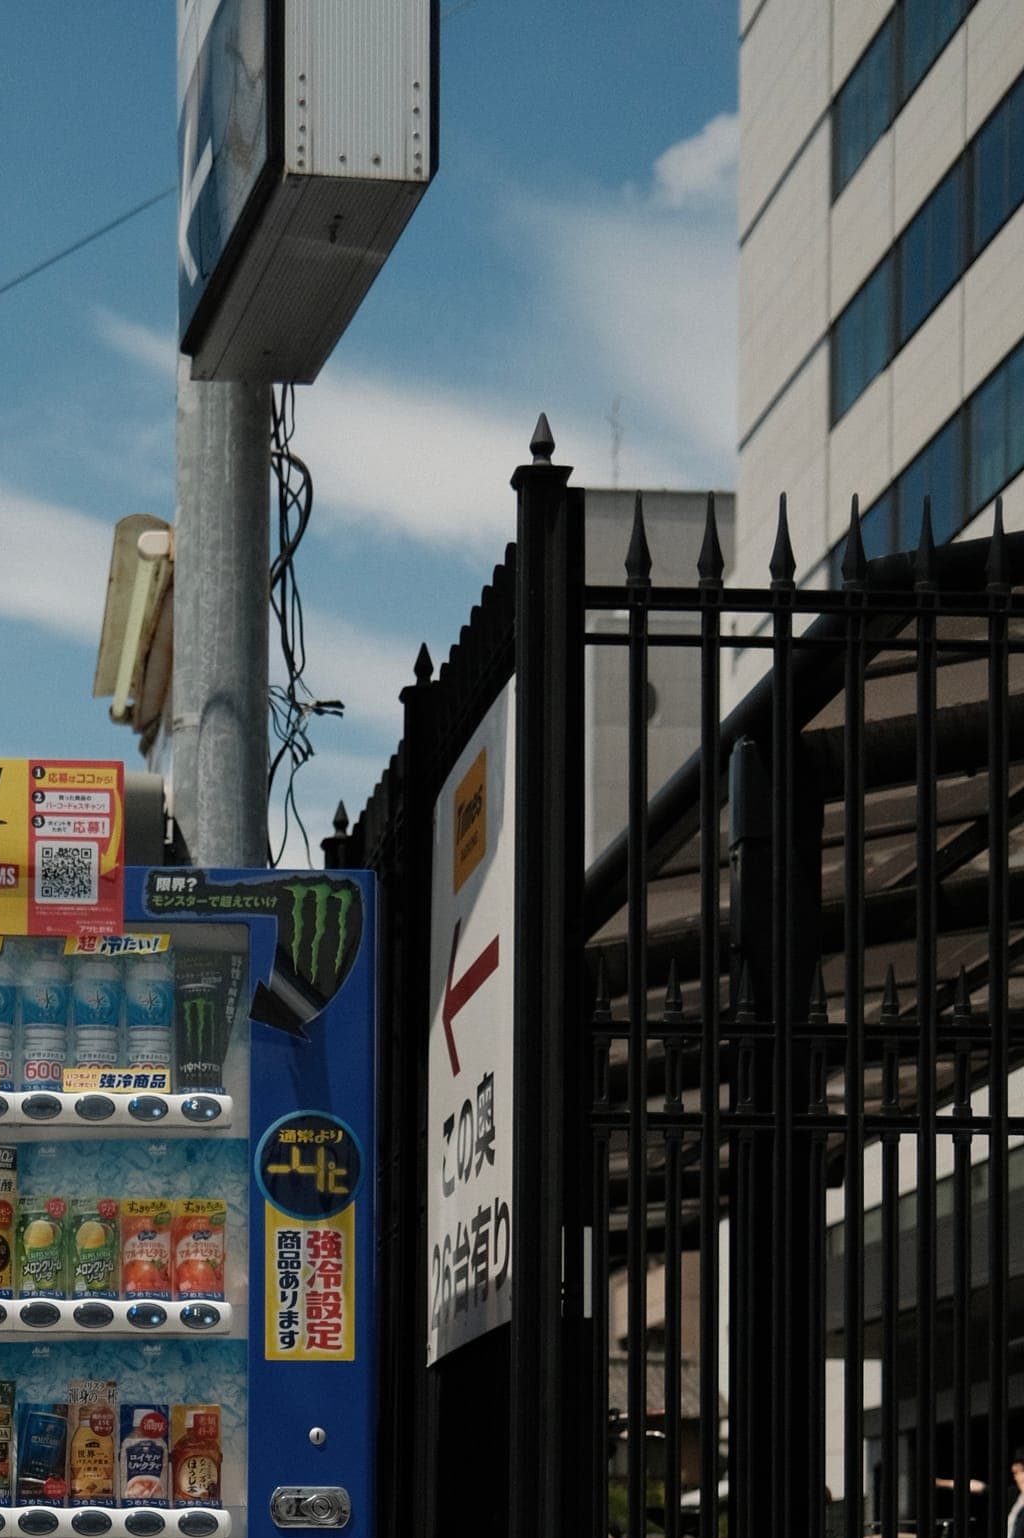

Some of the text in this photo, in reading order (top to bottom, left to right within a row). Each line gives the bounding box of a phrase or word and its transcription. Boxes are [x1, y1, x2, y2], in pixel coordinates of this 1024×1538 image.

[156, 877, 197, 892] 限界?
[152, 895, 278, 909] モンスターで超えていけ
[25, 1061, 62, 1080] 600
[99, 1072, 167, 1089] 強冷商品
[278, 1129, 344, 1144] 通常より
[441, 1072, 496, 1199] この奥
[23, 1260, 62, 1276] メロンクリーム
[75, 1261, 114, 1277] メロンクリーム
[431, 1197, 510, 1331] 26台有り
[277, 1230, 302, 1350] 商品あります
[306, 1230, 343, 1350] 強冷設定
